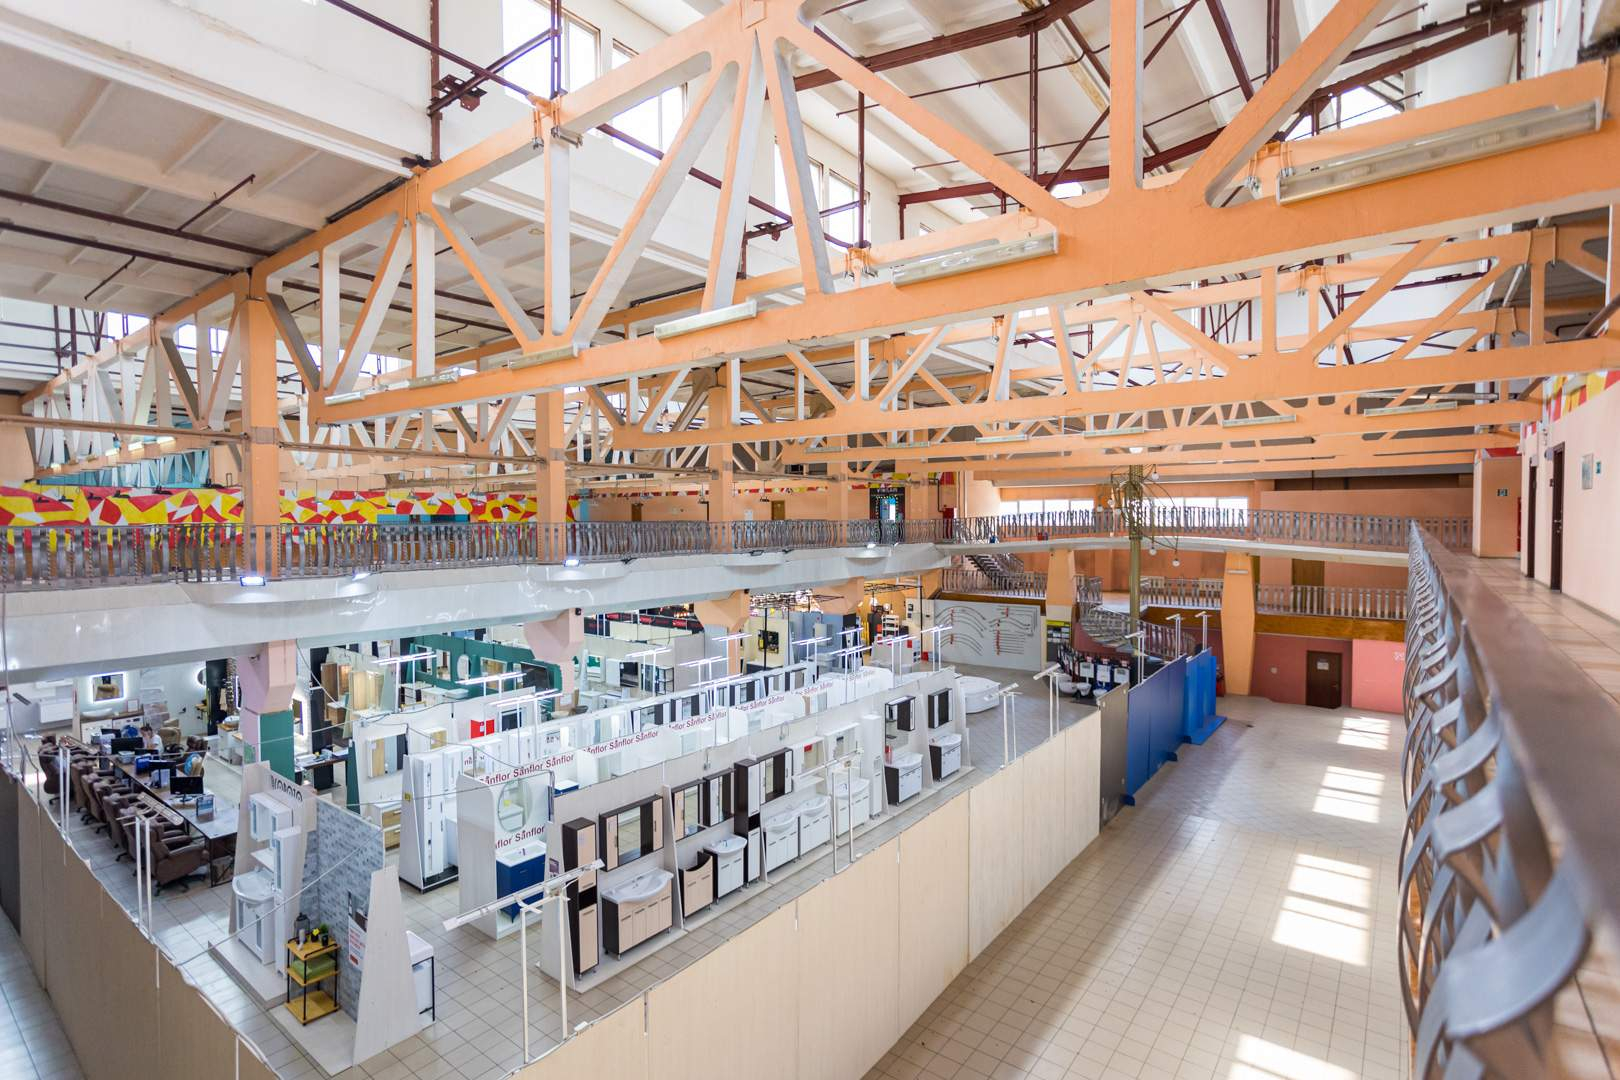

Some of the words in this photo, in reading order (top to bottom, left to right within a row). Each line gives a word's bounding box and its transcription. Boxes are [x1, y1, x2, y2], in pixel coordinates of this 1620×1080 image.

[480, 771, 511, 786] ånflor
[513, 763, 544, 778] Sånflor
[546, 753, 574, 769] Sånflor
[515, 825, 545, 842] Sånflor
